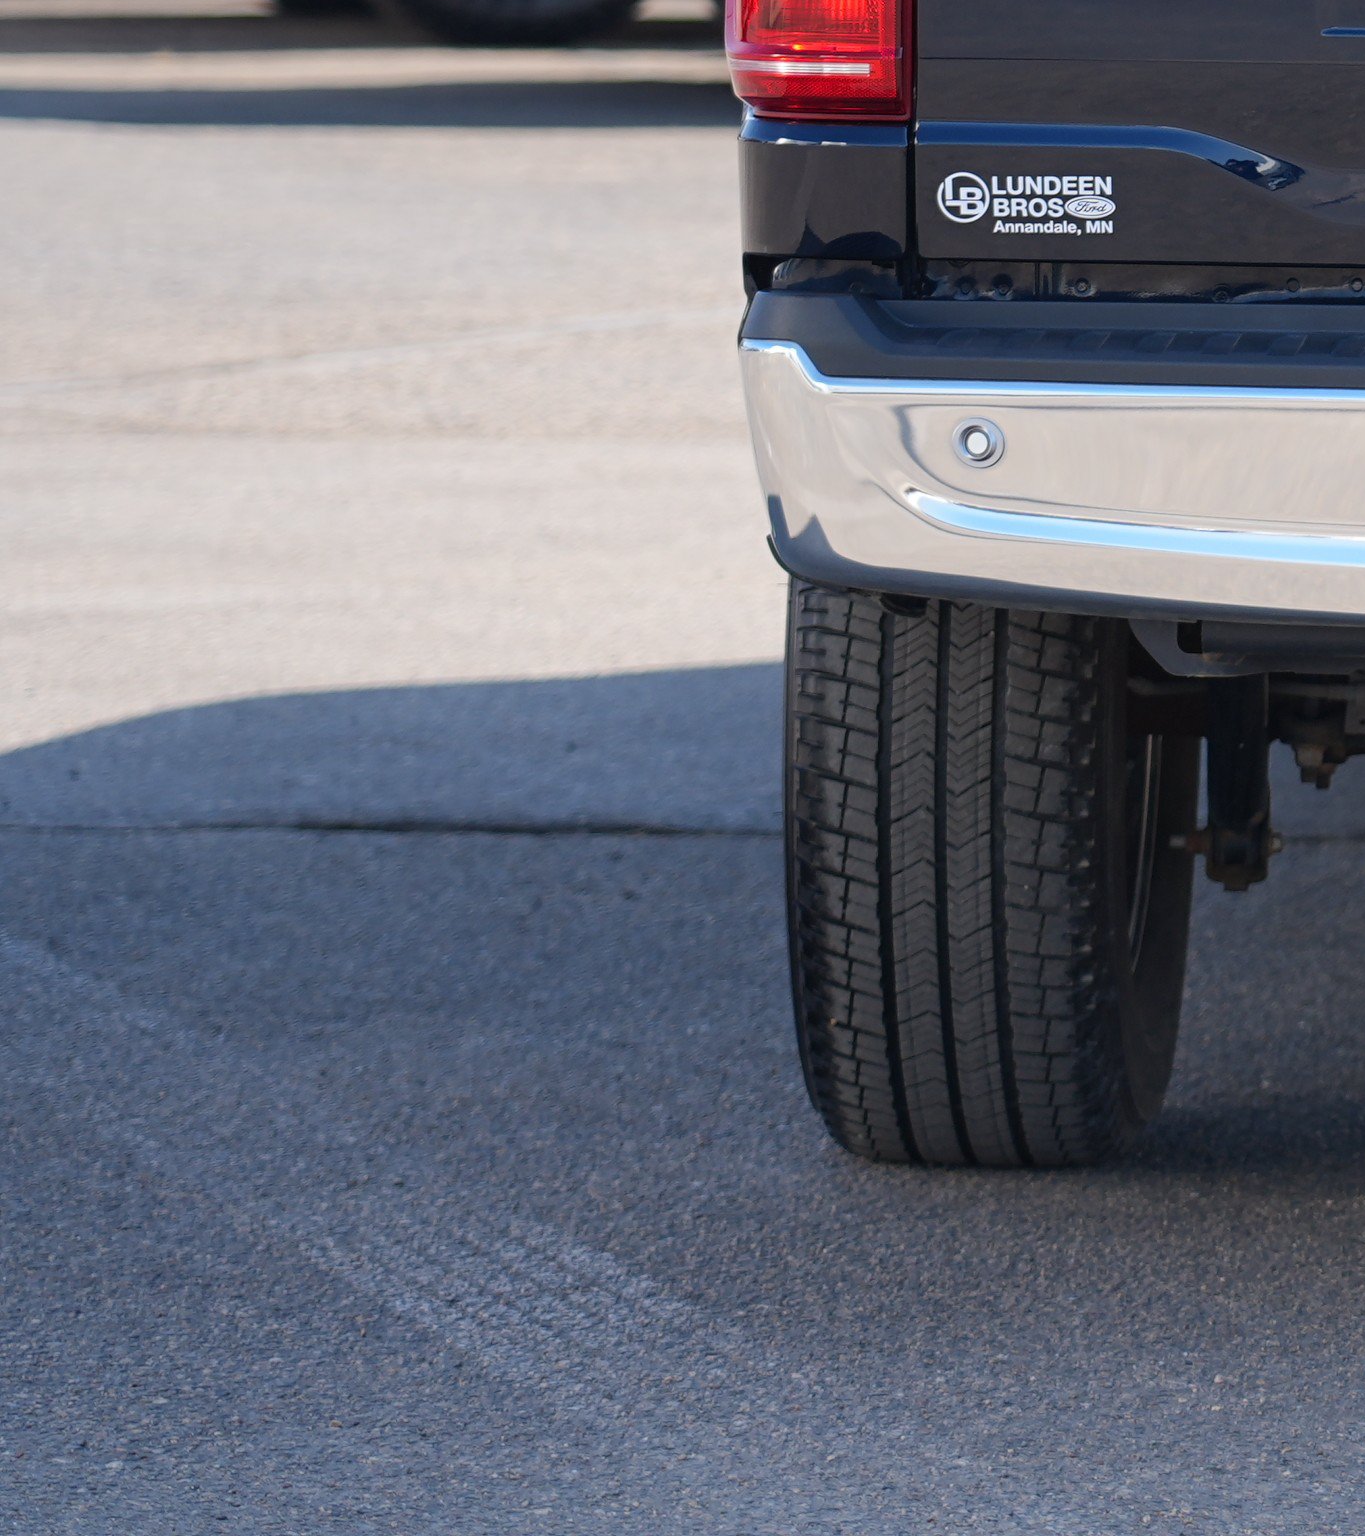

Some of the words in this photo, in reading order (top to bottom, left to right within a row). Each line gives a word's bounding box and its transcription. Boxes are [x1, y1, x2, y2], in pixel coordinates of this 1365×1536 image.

[991, 175, 1113, 196] LUNDEEN
[992, 197, 1065, 218] BROS
[1074, 201, 1108, 213] Ford
[992, 220, 1082, 236] Annandale,
[1086, 220, 1114, 234] MN
